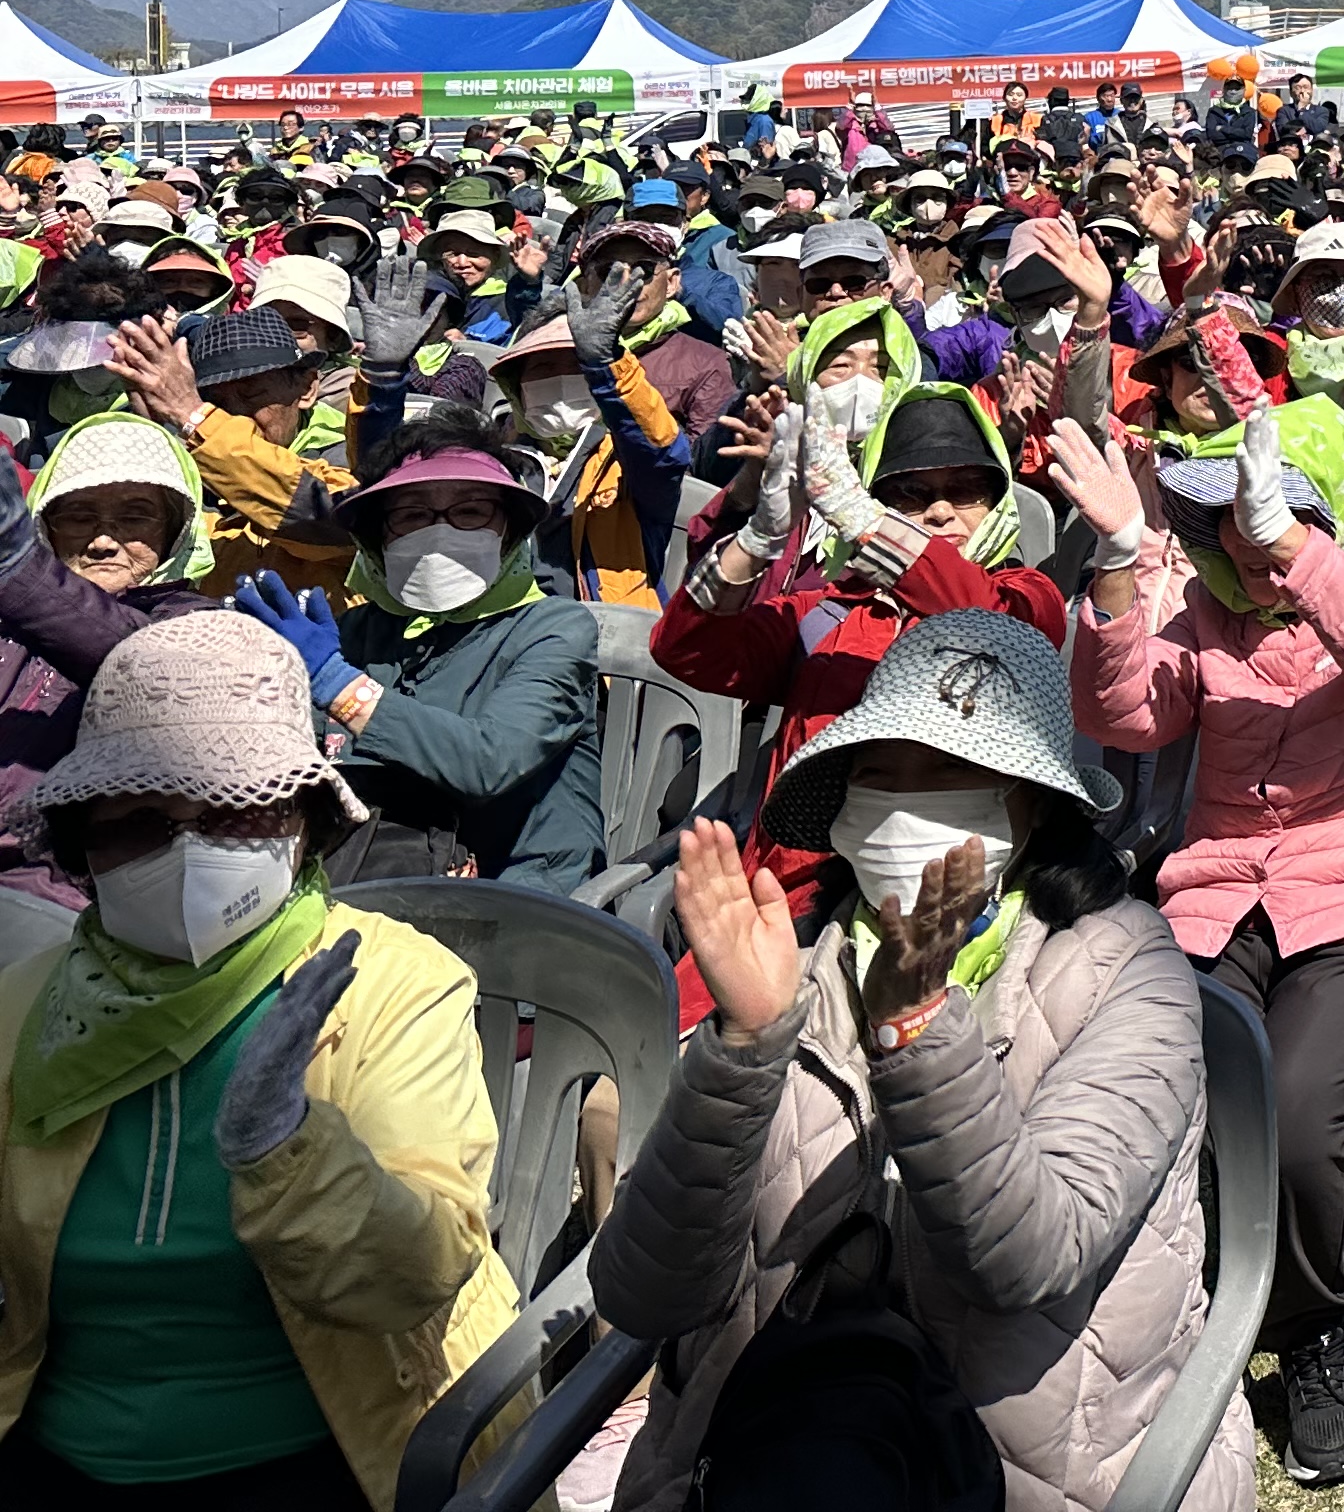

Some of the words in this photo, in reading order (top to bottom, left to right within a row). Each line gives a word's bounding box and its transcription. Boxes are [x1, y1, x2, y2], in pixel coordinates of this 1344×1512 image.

[803, 69, 876, 89] 해양누리
[880, 66, 953, 87] 동행마켓
[1022, 62, 1040, 81] 김
[1059, 60, 1115, 80] 시니어
[340, 81, 375, 99] 무료
[379, 81, 415, 98] 시음
[444, 79, 498, 96] 올바른
[503, 78, 574, 96] 치아관리
[577, 77, 614, 95] 체험
